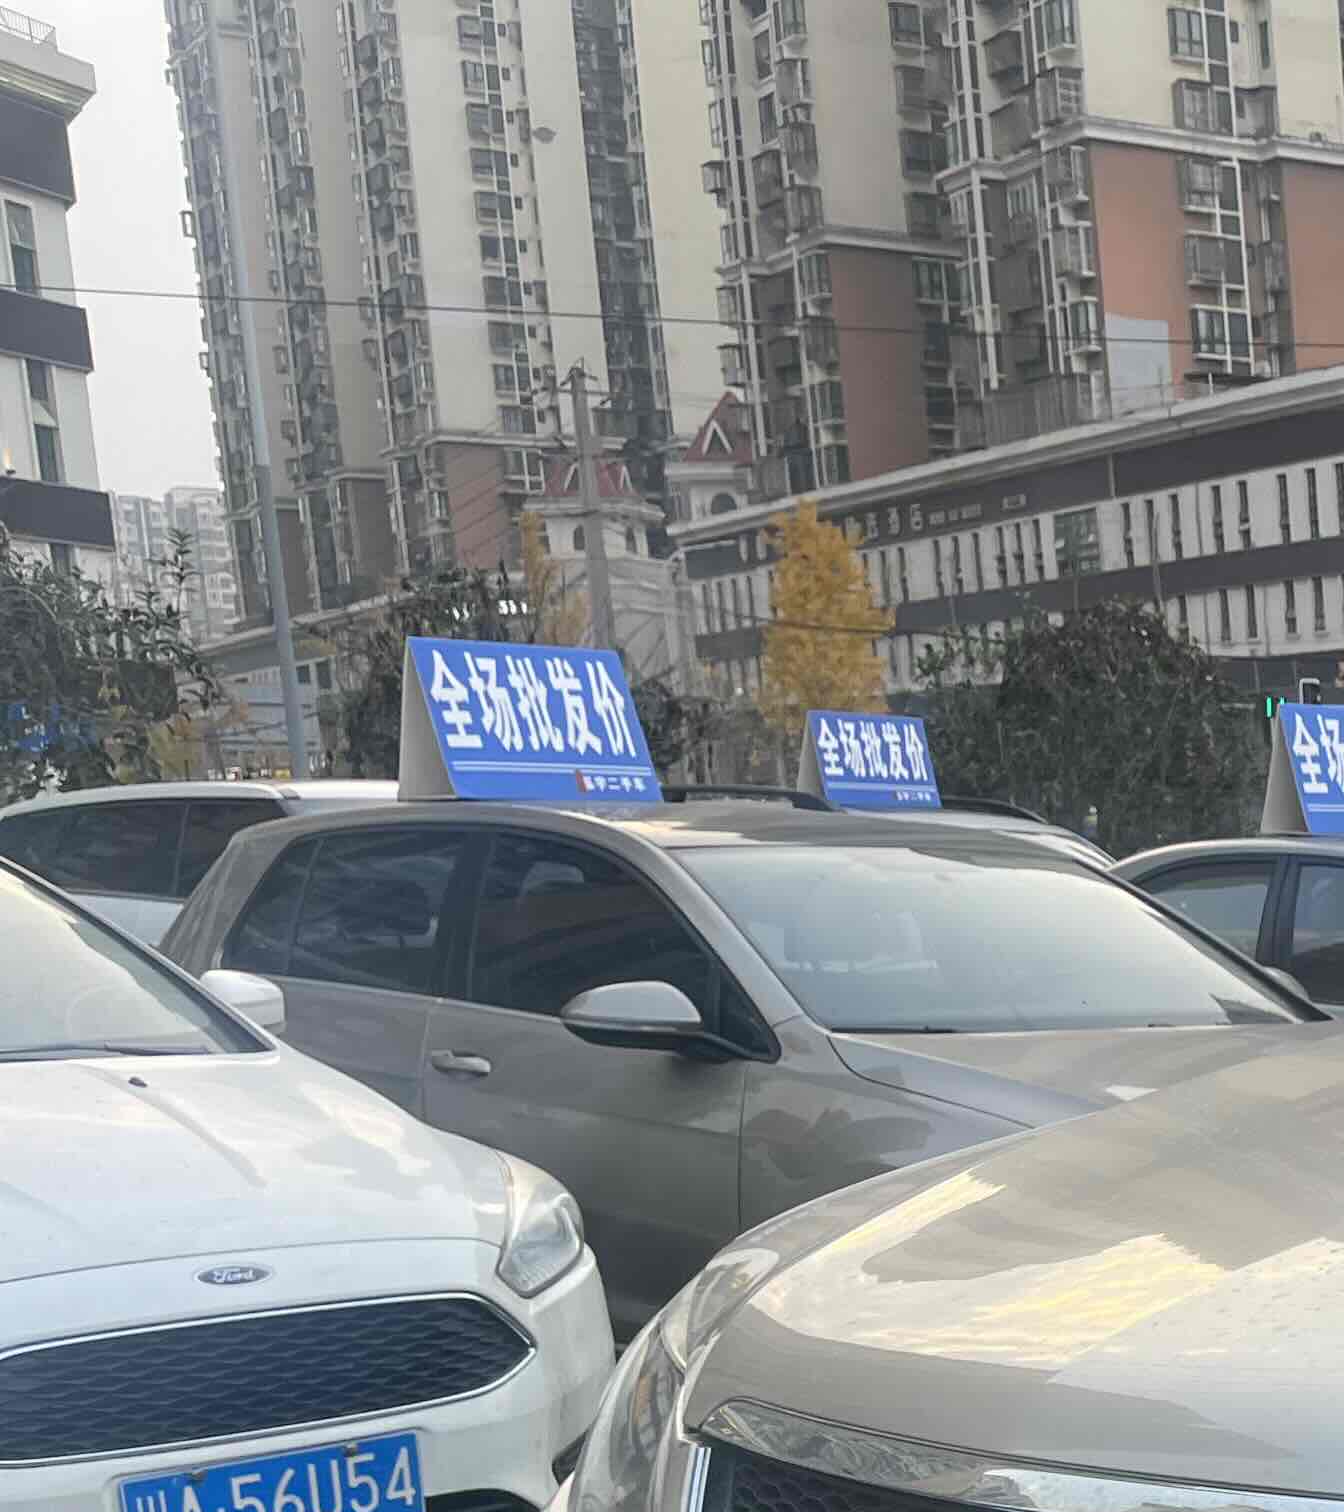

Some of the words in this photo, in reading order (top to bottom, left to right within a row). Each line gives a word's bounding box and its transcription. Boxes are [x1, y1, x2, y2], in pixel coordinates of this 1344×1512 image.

[430, 649, 637, 757] 全场批发价
[817, 717, 929, 781] 全场批发价
[212, 1268, 257, 1284] Ford
